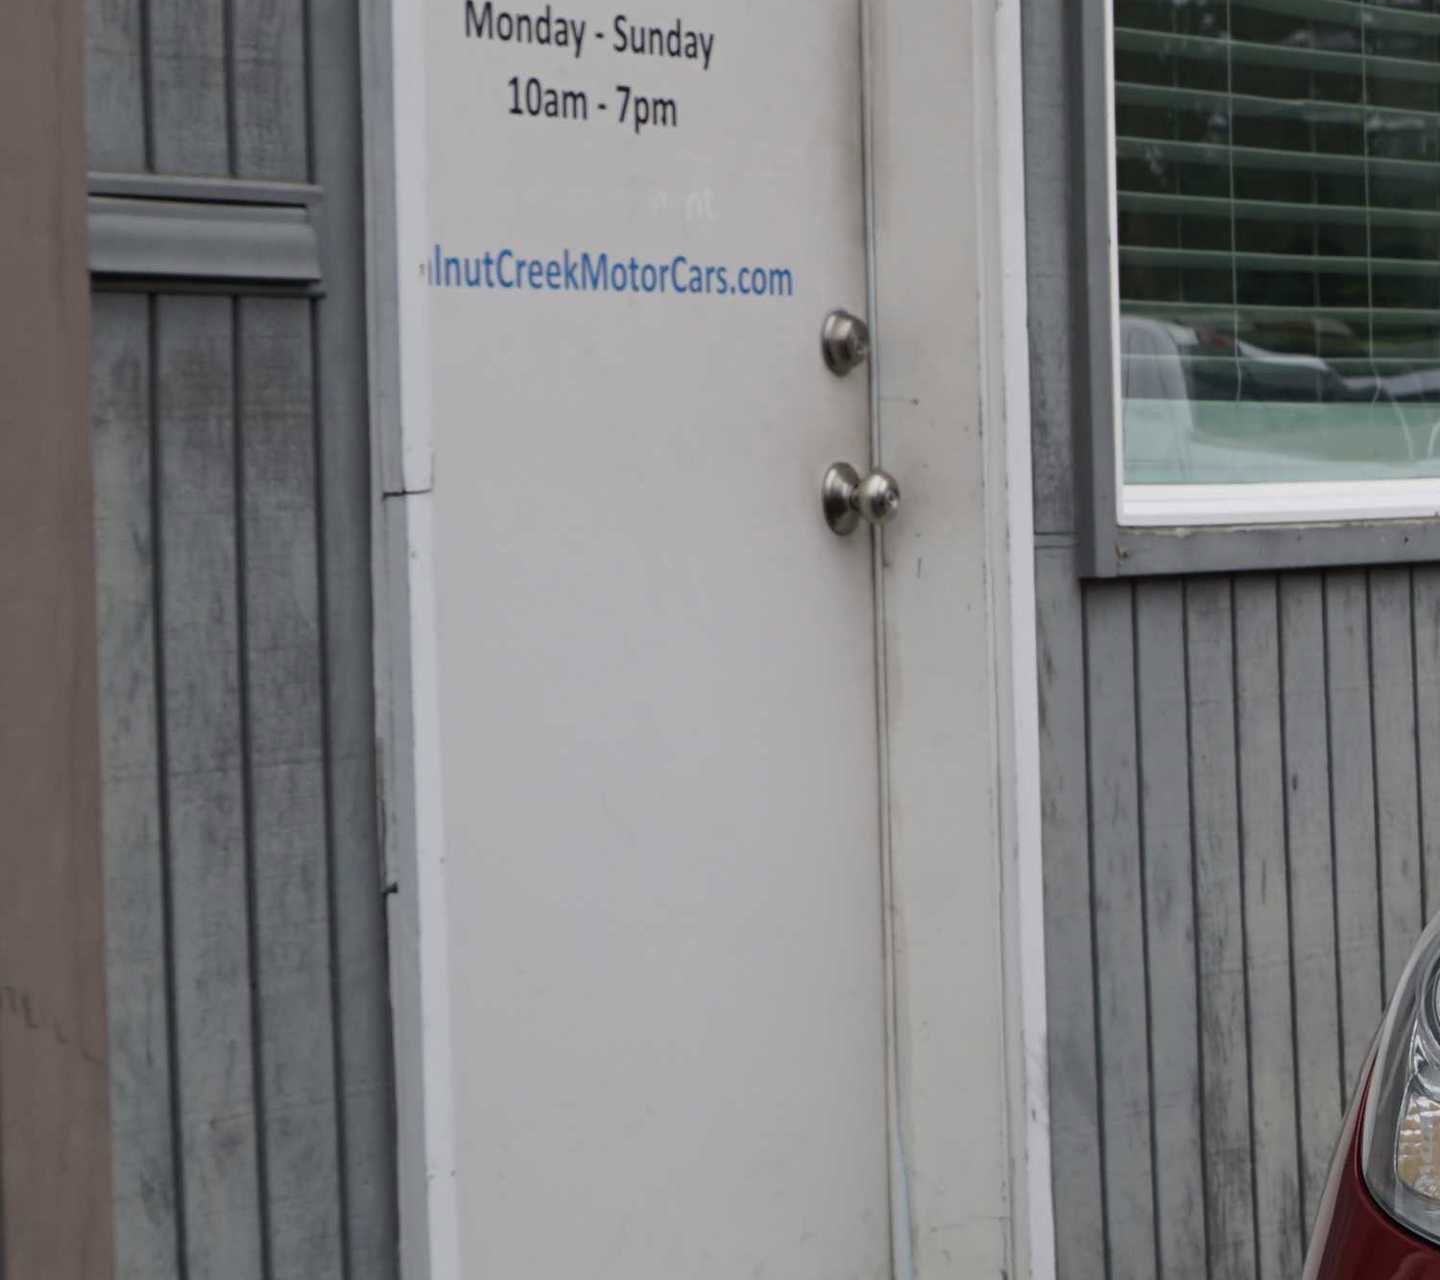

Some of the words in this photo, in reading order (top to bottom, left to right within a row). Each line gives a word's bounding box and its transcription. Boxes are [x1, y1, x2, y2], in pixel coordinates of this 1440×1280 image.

[613, 14, 715, 70] Sunday
[508, 76, 588, 120] 10am
[616, 85, 678, 134] 7pm
[428, 243, 793, 296] lnutCreekMotorCars.com
